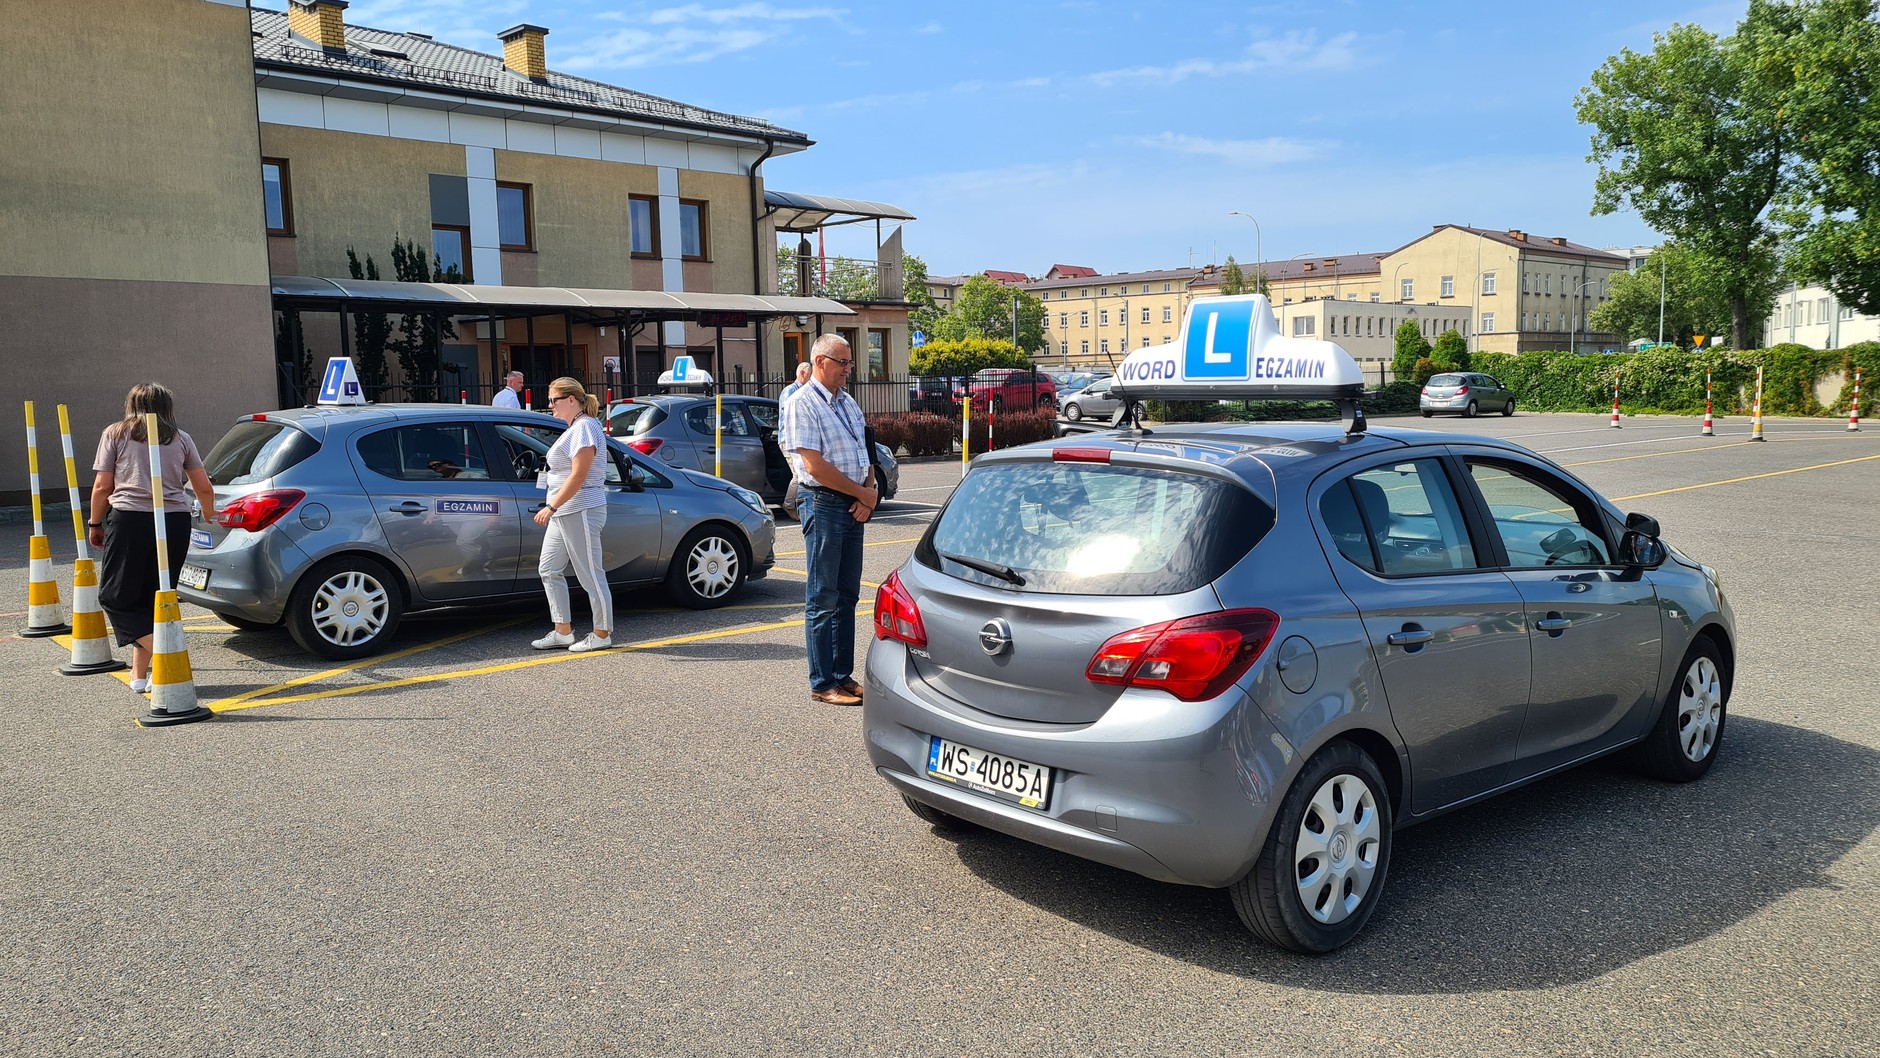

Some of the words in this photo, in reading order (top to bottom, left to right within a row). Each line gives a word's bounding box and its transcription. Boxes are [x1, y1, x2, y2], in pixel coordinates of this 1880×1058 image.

[1204, 312, 1232, 364] L
[677, 360, 683, 377] L
[1123, 359, 1176, 381] WORD
[1255, 357, 1326, 379] EGZAMIN
[326, 365, 337, 395] L
[348, 383, 356, 394] L
[443, 502, 493, 512] EGZAMIN
[930, 757, 937, 767] PL
[941, 743, 970, 776] WS
[976, 754, 1042, 800] 4085A
